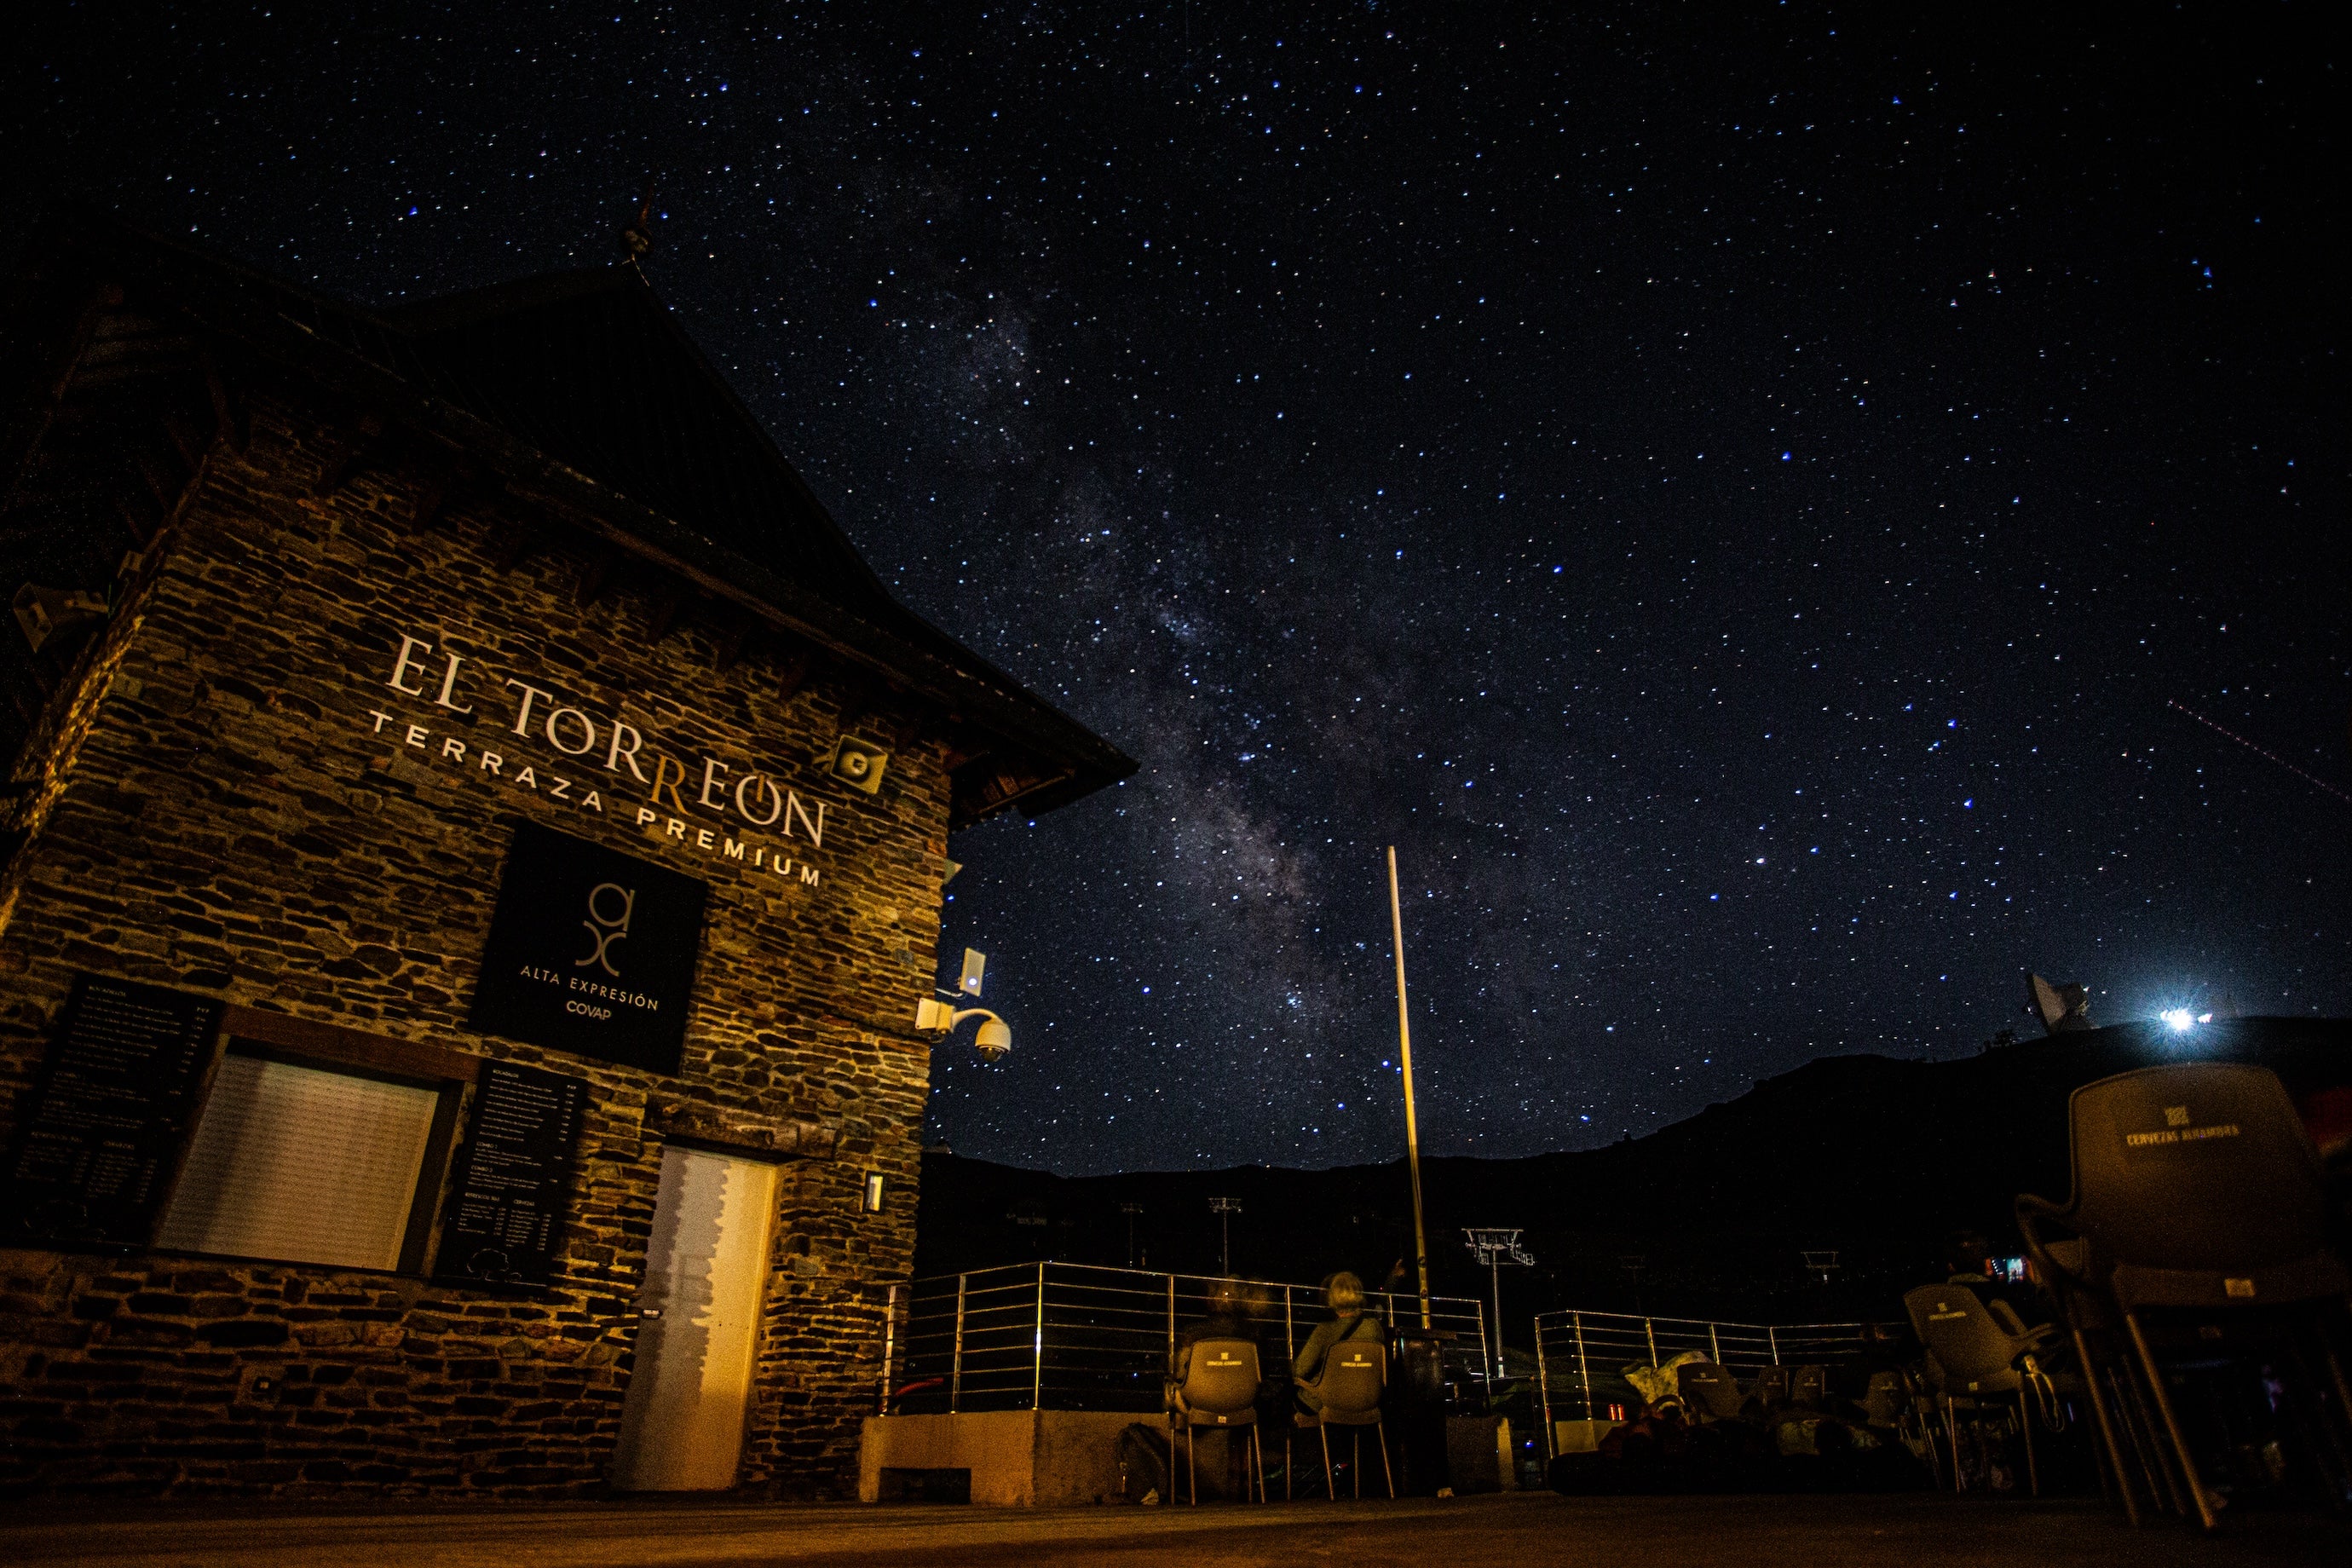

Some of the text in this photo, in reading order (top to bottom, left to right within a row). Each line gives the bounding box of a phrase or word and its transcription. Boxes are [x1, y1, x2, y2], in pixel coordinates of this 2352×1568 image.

[385, 634, 473, 714] EL
[368, 711, 820, 887] TERRAZA PREMIUM
[520, 966, 659, 1012] ALTA EXPRESIÓN
[566, 1000, 612, 1021] COVAP
